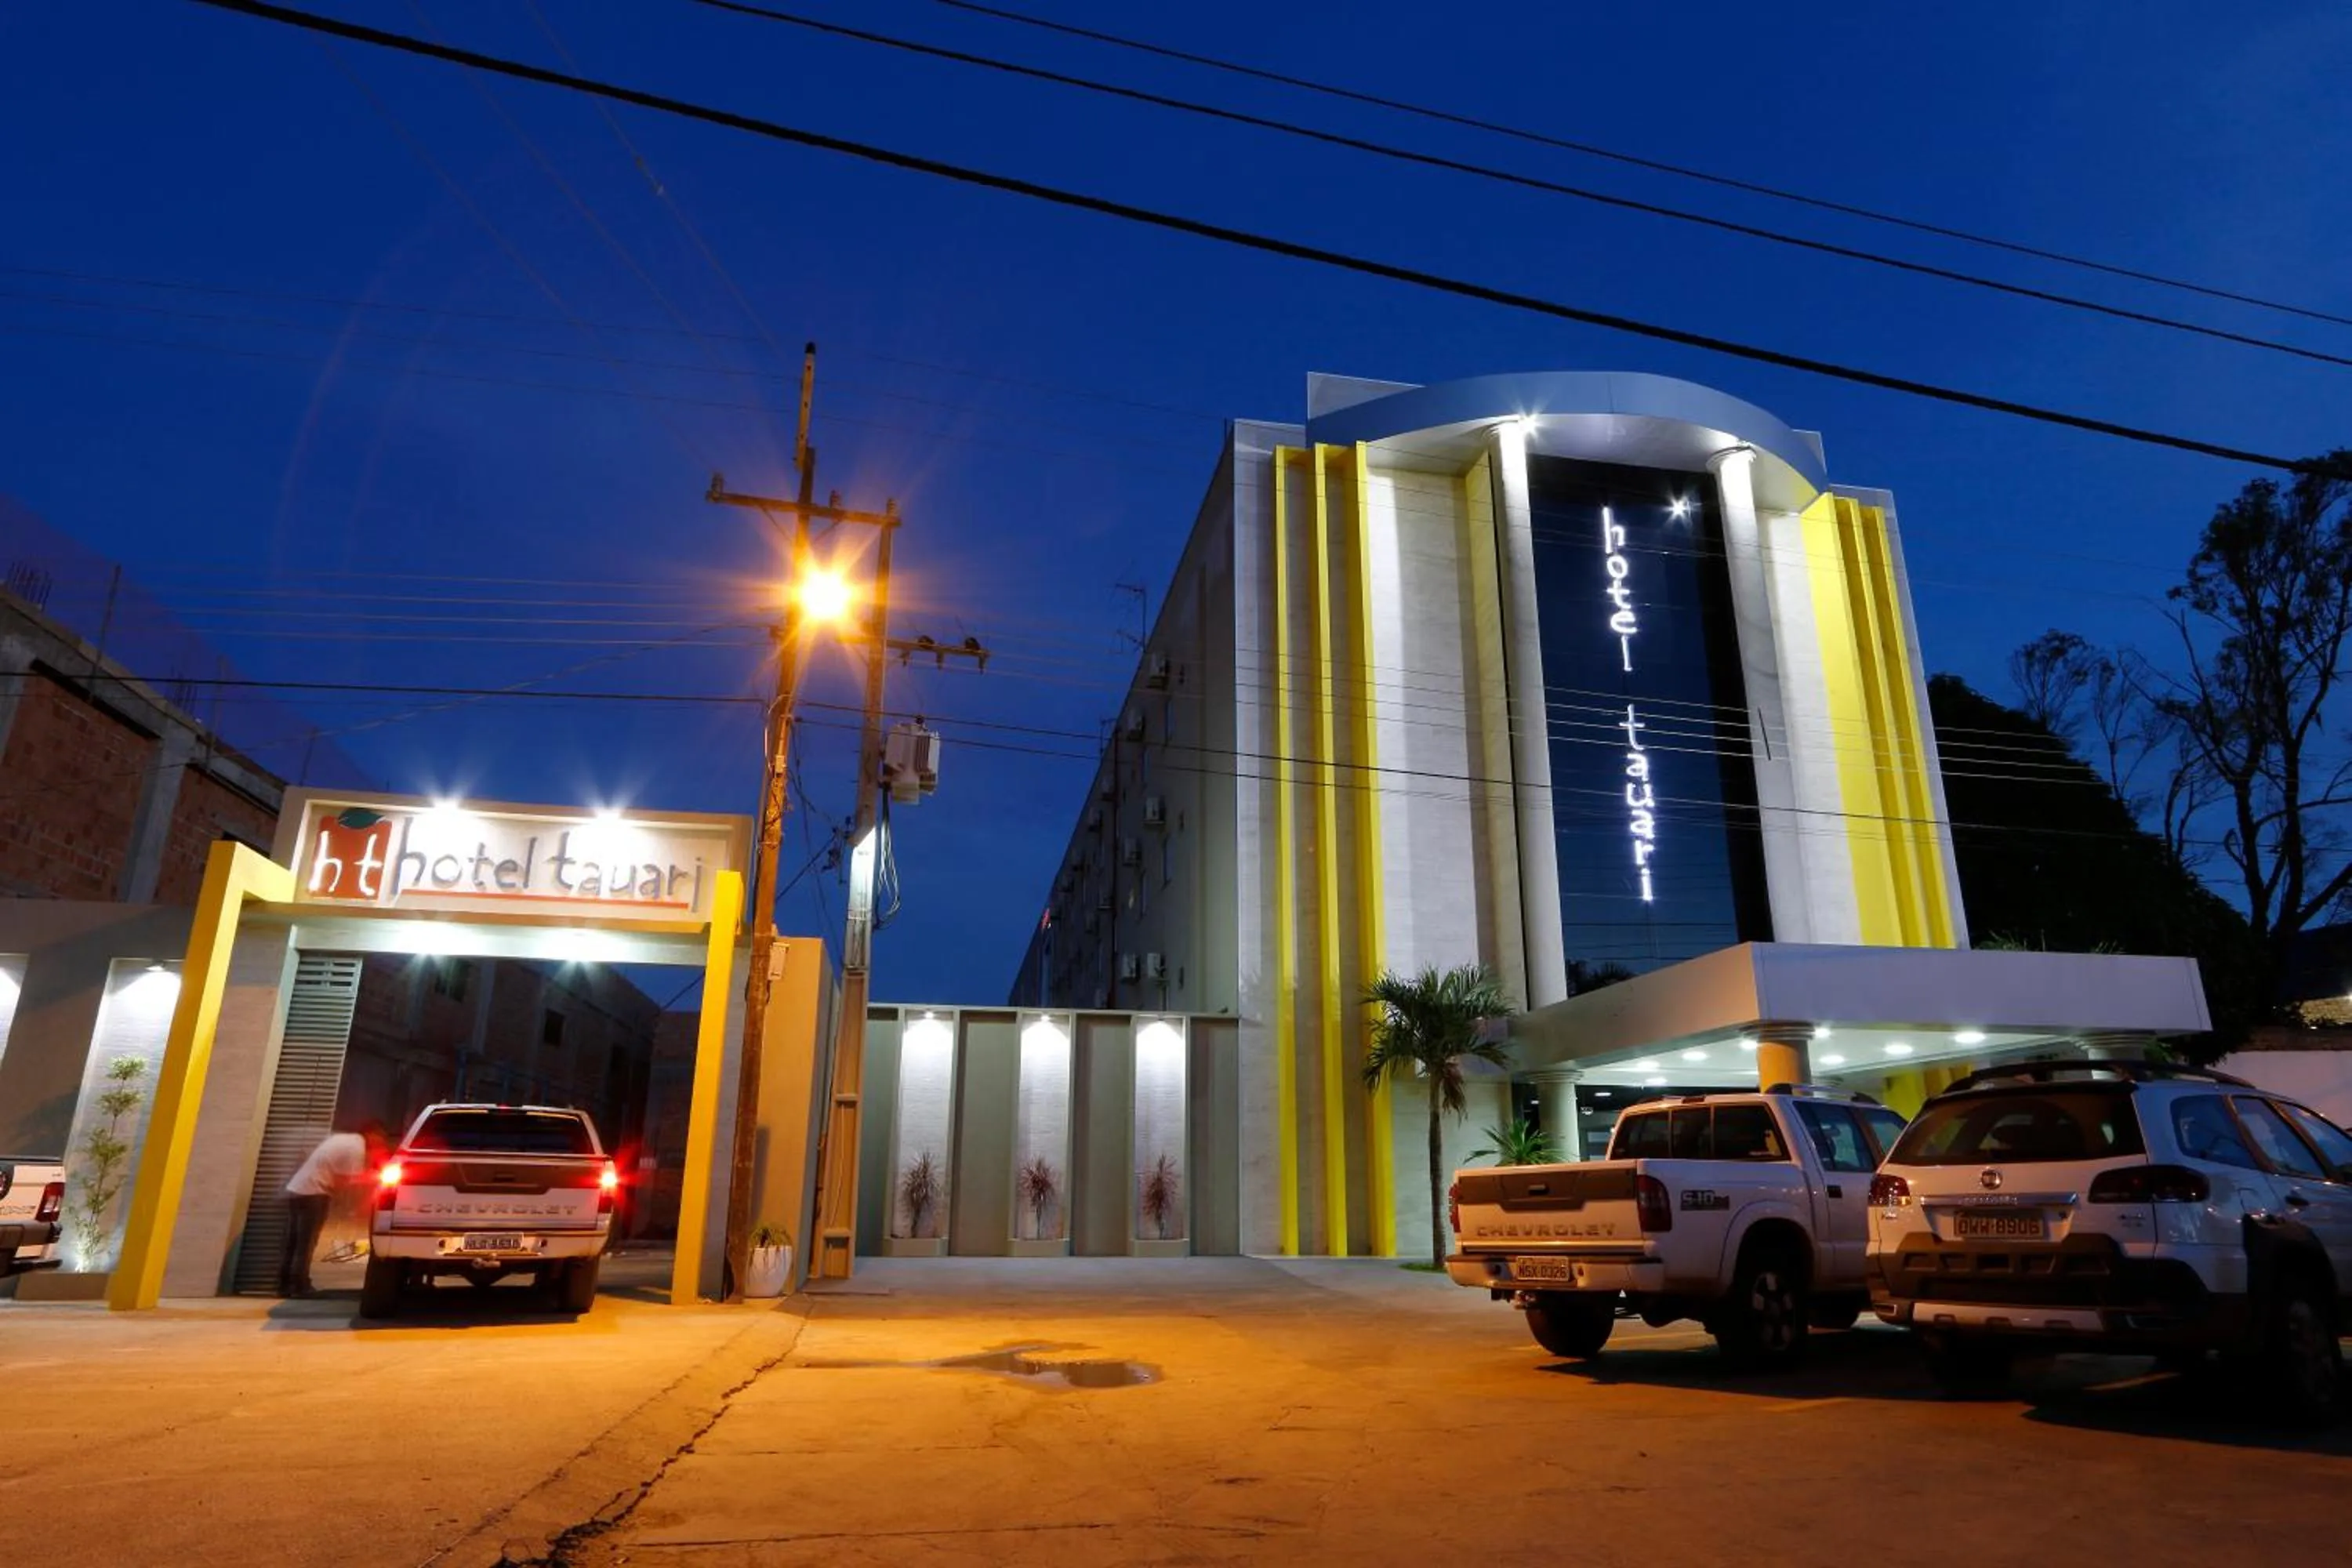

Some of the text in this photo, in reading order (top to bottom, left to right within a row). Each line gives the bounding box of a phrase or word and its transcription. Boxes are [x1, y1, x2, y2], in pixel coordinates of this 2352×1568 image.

[1602, 506, 1655, 902] hotel tauari
[308, 829, 383, 896] ht
[390, 815, 704, 913] hotel tauari
[417, 1203, 577, 1215] CHEVROLET
[1477, 1223, 1617, 1237] CHEVROLET
